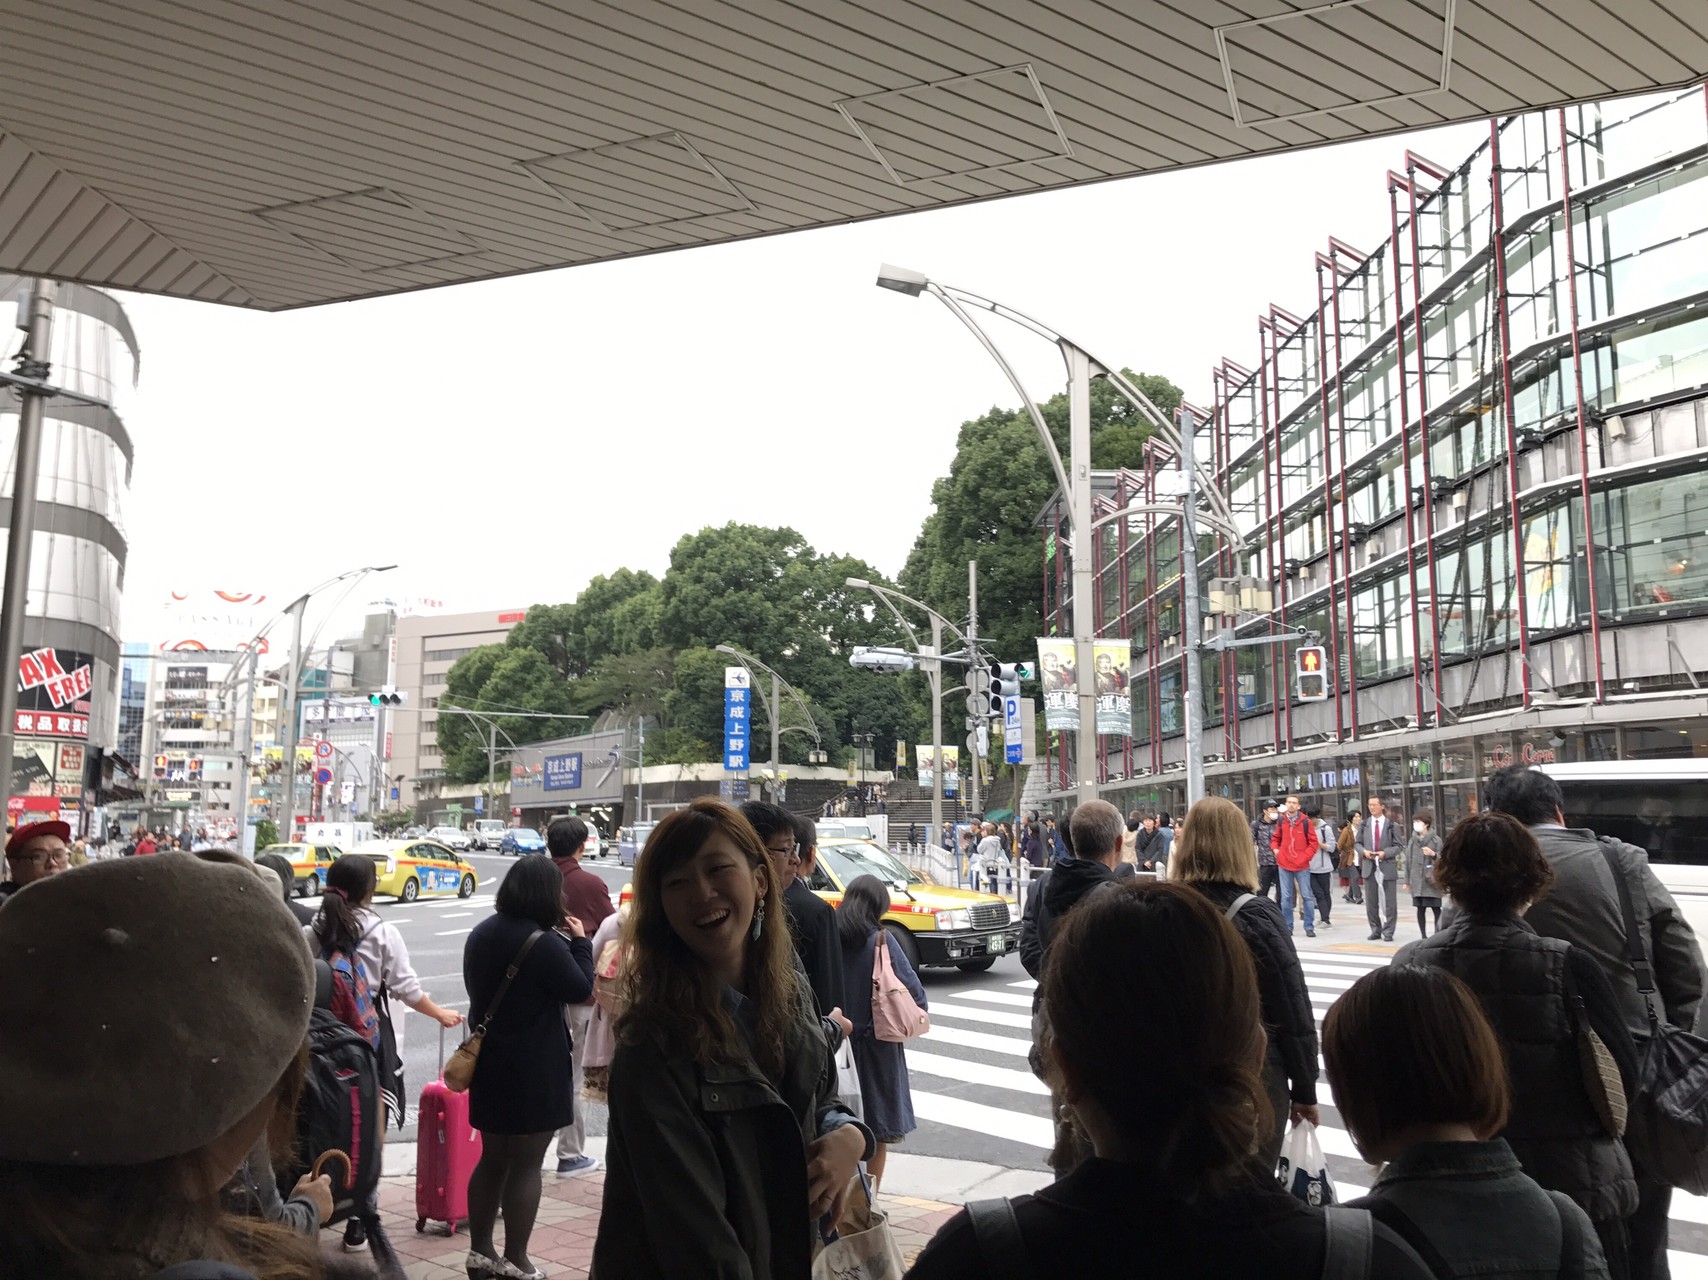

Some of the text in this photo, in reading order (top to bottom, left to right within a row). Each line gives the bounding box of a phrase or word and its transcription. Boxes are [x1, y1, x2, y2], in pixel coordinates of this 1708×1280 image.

[17, 648, 63, 692] AX
[46, 666, 91, 707] FREE
[1007, 700, 1016, 725] P
[1043, 692, 1079, 710] 運慶
[1096, 695, 1131, 714] 運慶
[728, 689, 745, 768] 京成上野駅
[547, 757, 577, 774] 京成上野駅
